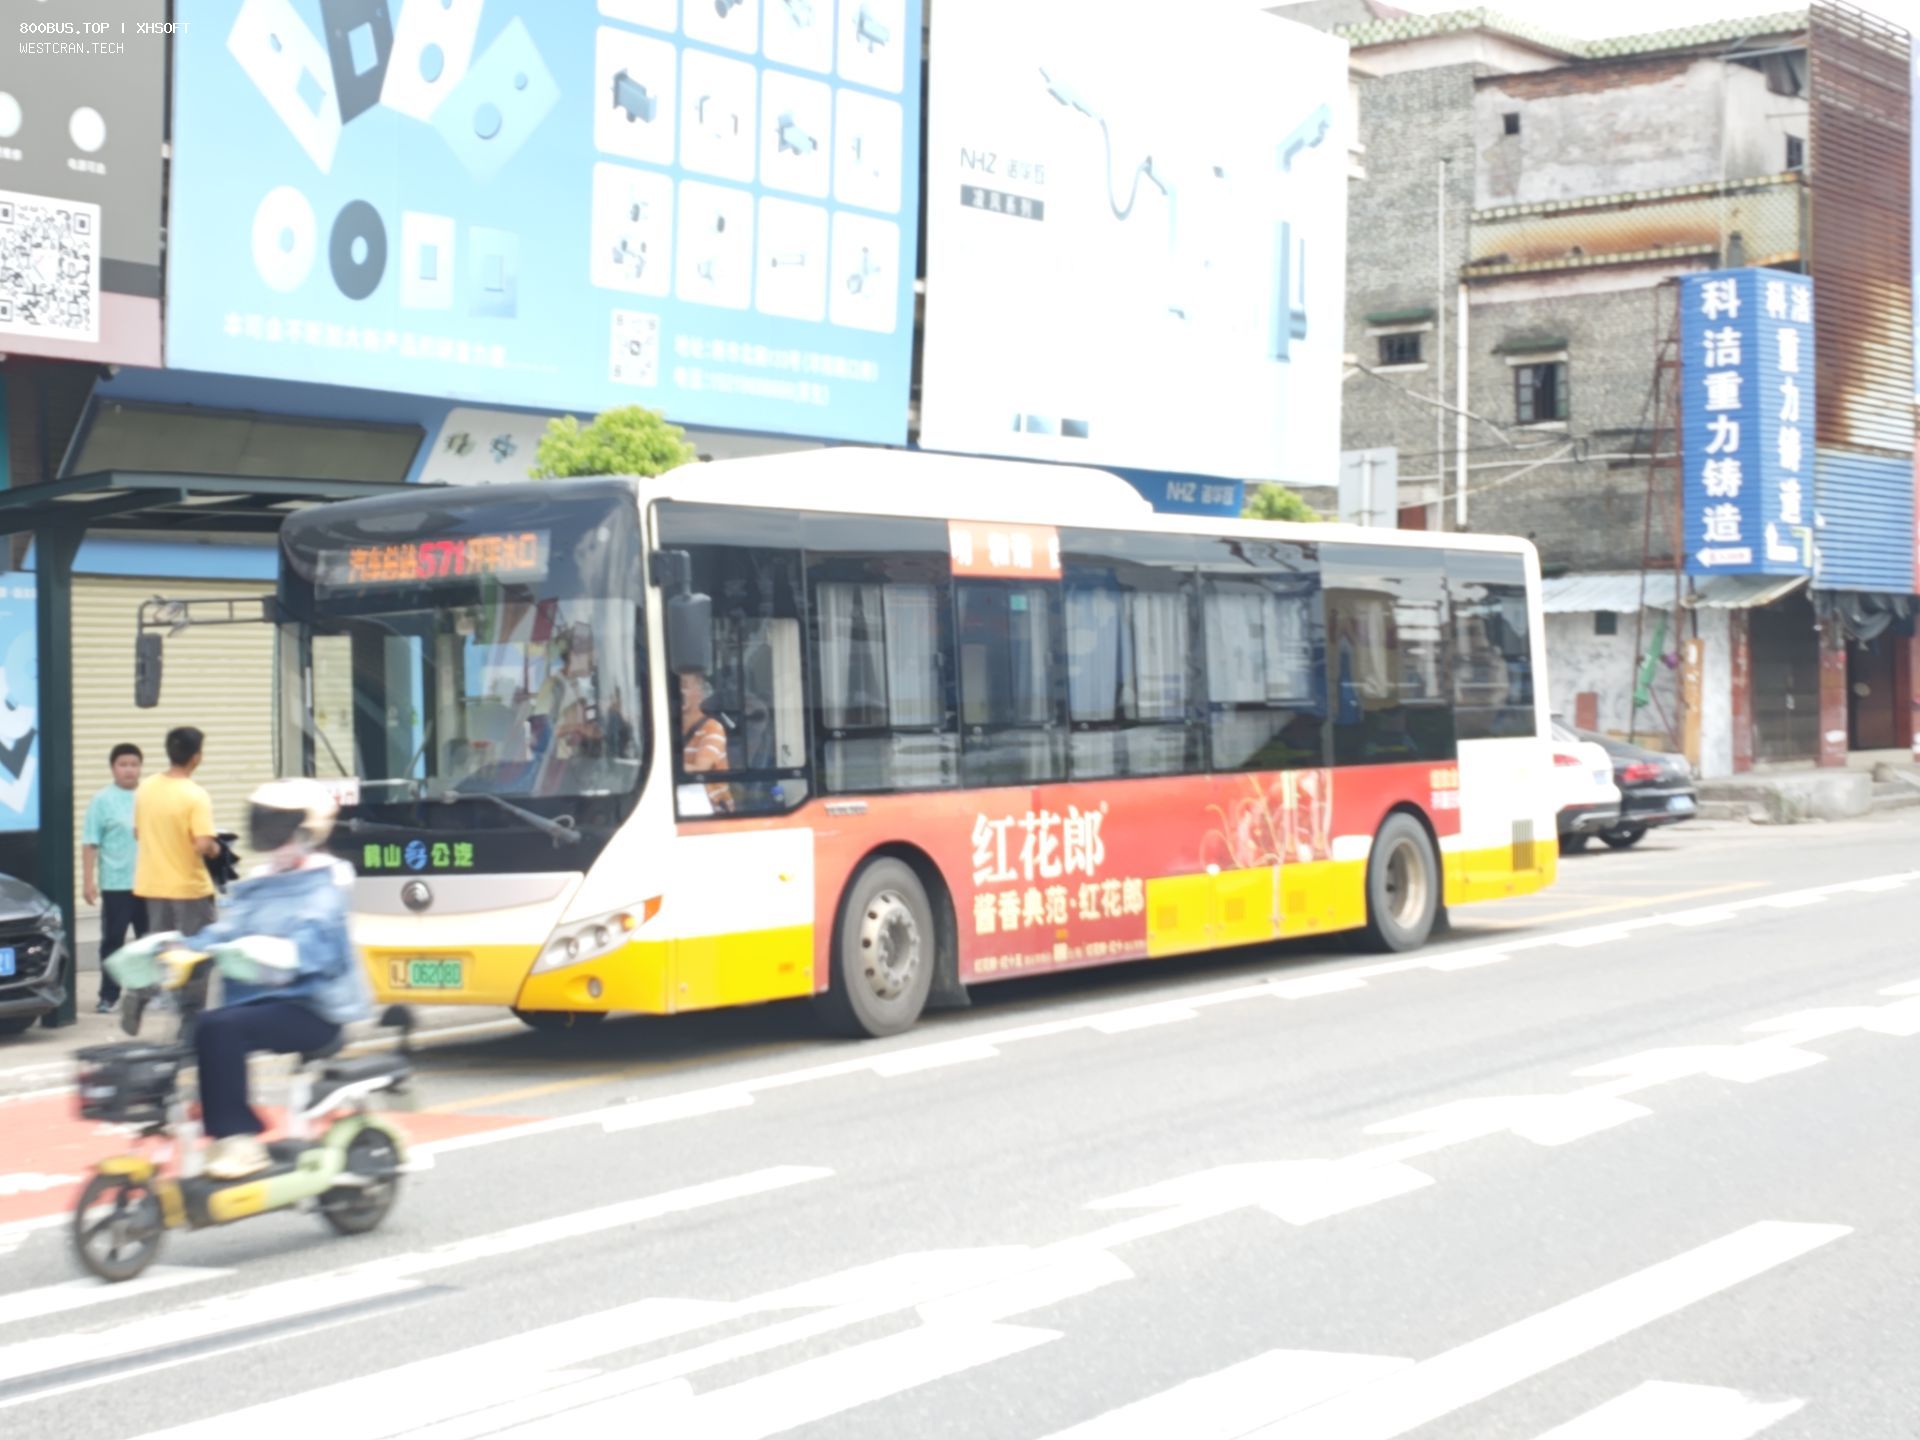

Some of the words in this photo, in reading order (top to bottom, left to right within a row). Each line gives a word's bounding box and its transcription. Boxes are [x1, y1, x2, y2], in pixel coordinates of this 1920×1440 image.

[1701, 277, 1743, 542] 科洁重力铸造
[415, 539, 466, 580] 571
[971, 804, 1105, 888] 红花郎
